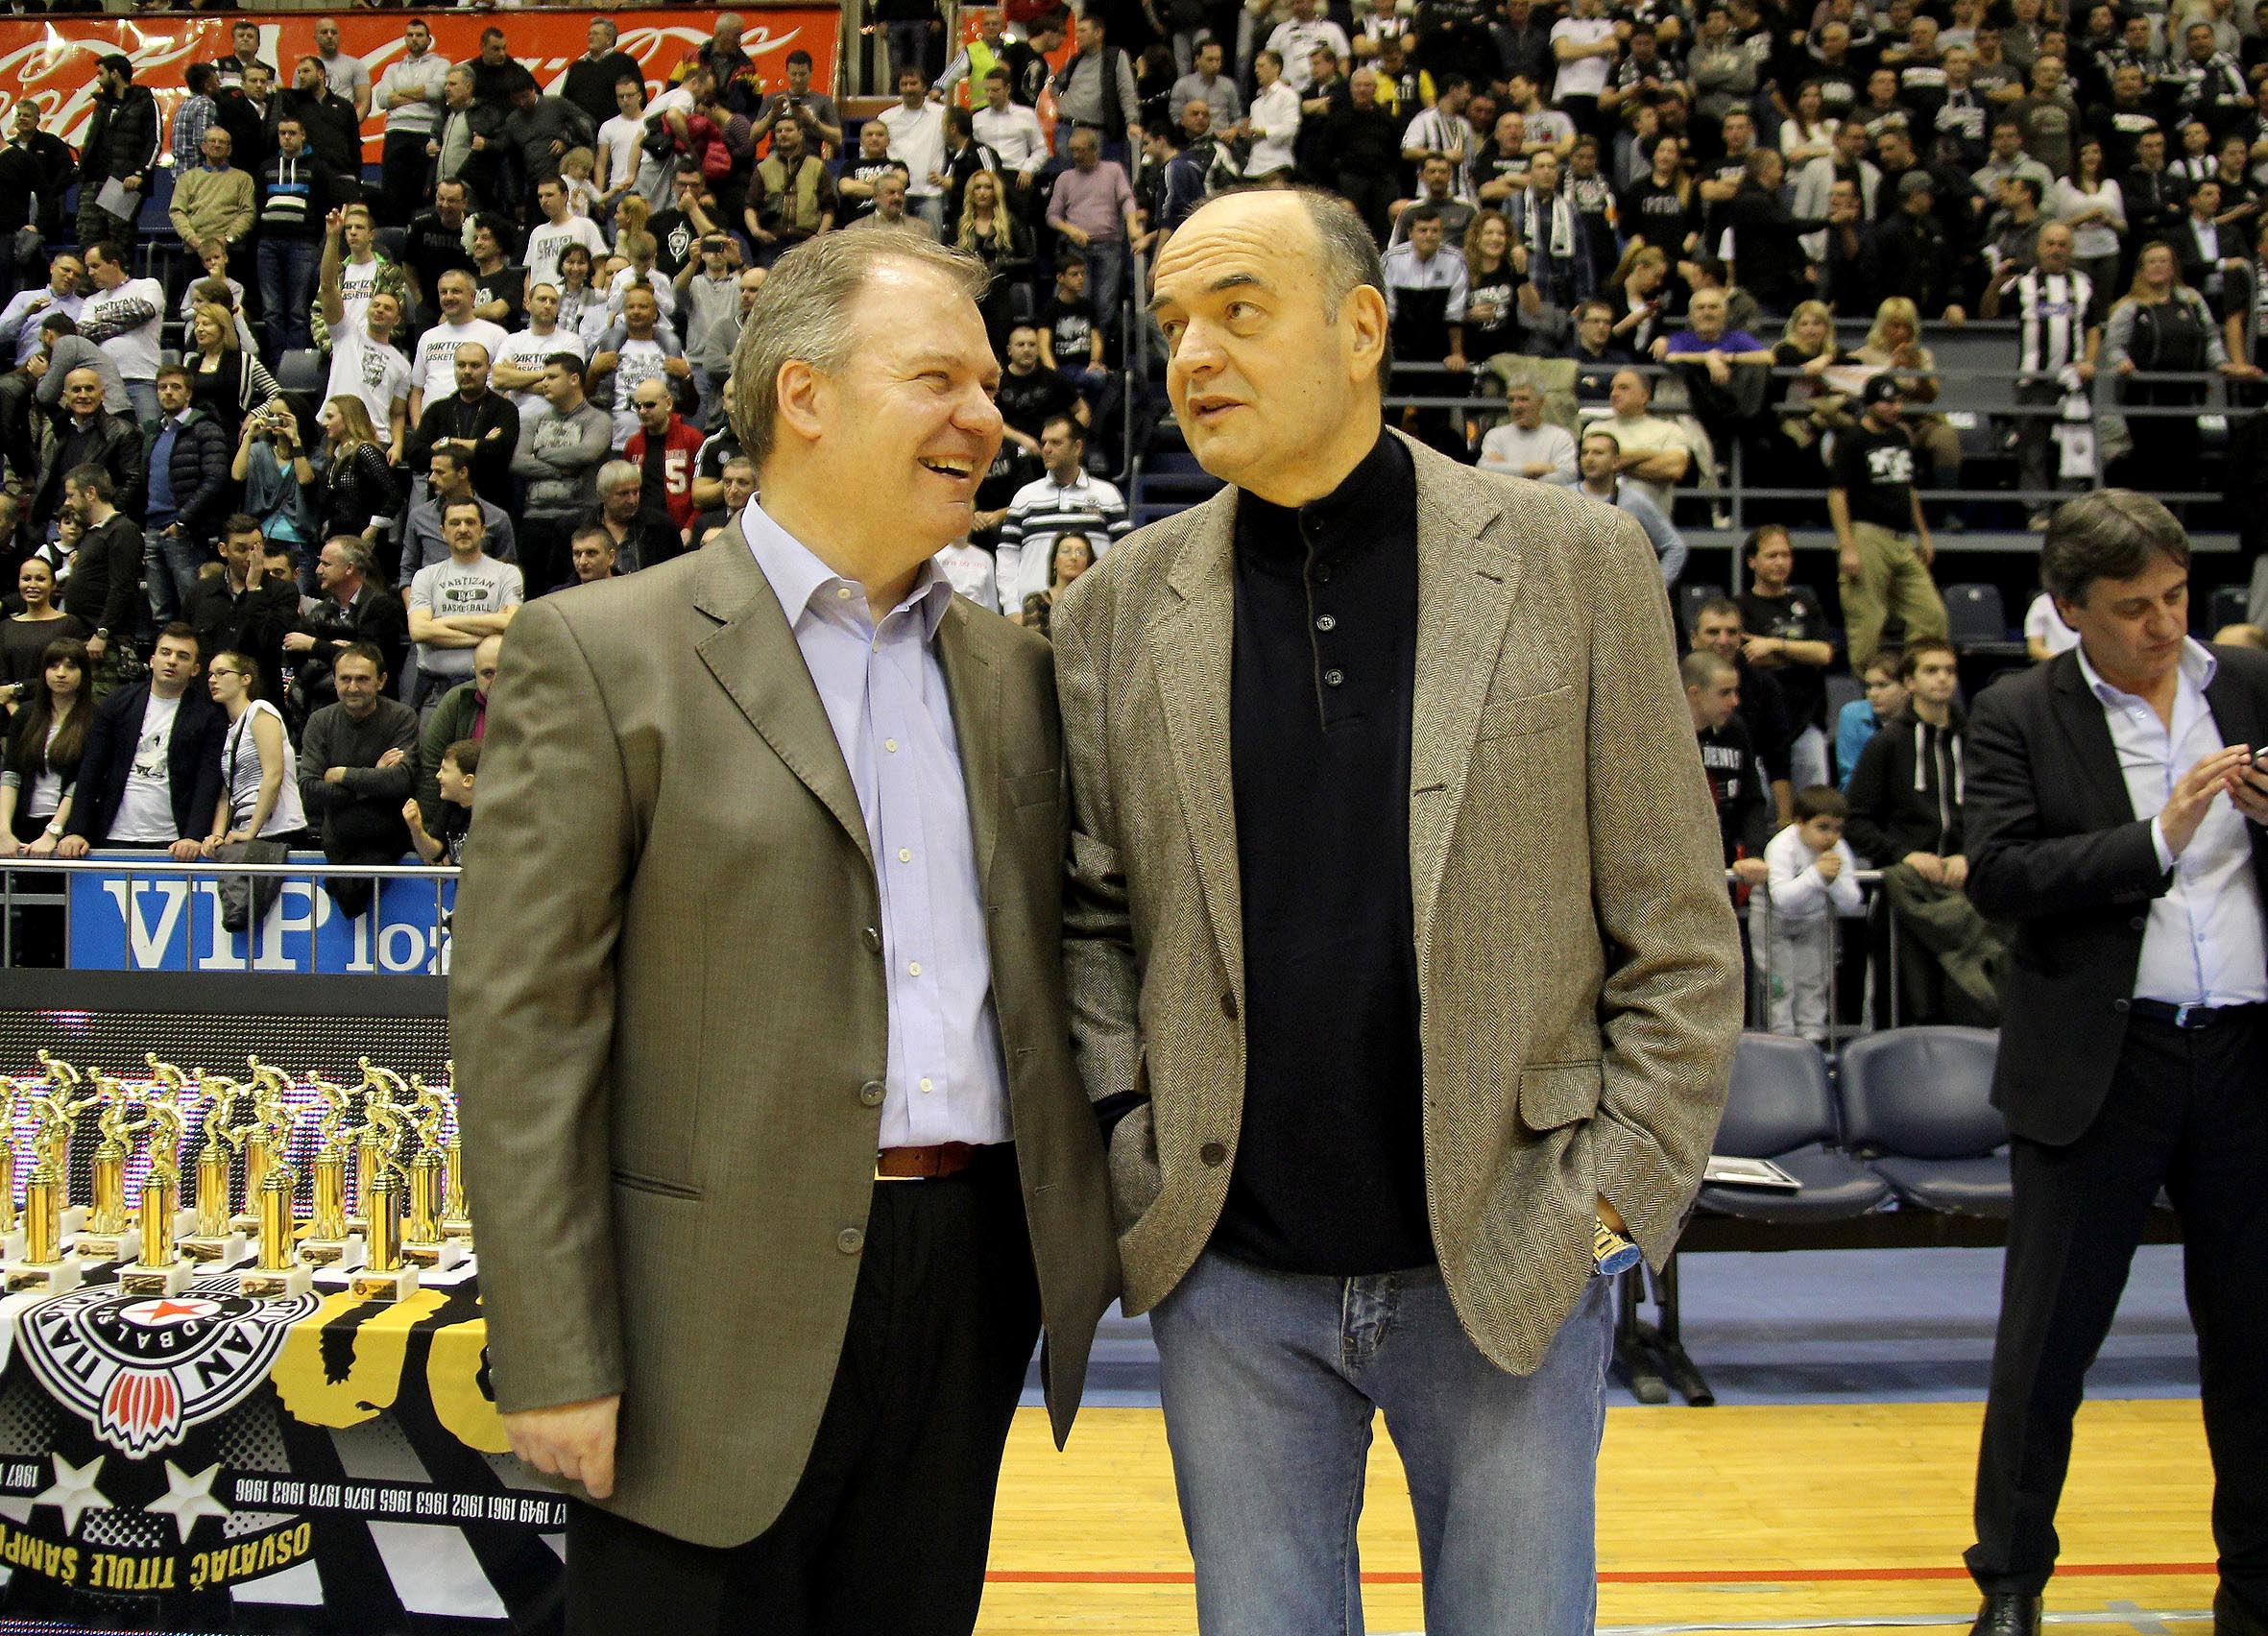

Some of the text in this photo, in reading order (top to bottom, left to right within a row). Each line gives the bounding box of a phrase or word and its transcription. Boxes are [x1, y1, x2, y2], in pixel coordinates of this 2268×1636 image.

[425, 341, 462, 352] PARTIZ
[665, 459, 688, 493] 5
[438, 576, 495, 589] PARTIZAN
[442, 603, 492, 613] BASKETBALL
[103, 879, 331, 971] VIP
[5, 1463, 39, 1488] 1987
[235, 1478, 268, 1503] 1986
[272, 1480, 304, 1504] 1983
[309, 1482, 340, 1507] 1978
[344, 1485, 375, 1511] 1976
[379, 1488, 411, 1514] 1965
[416, 1490, 448, 1517] 1963
[452, 1493, 483, 1519] 1962
[488, 1496, 517, 1522] 1961
[519, 1498, 549, 1525] 1949
[189, 1522, 312, 1592] OSVAJAČ
[89, 1552, 176, 1591] TITULE
